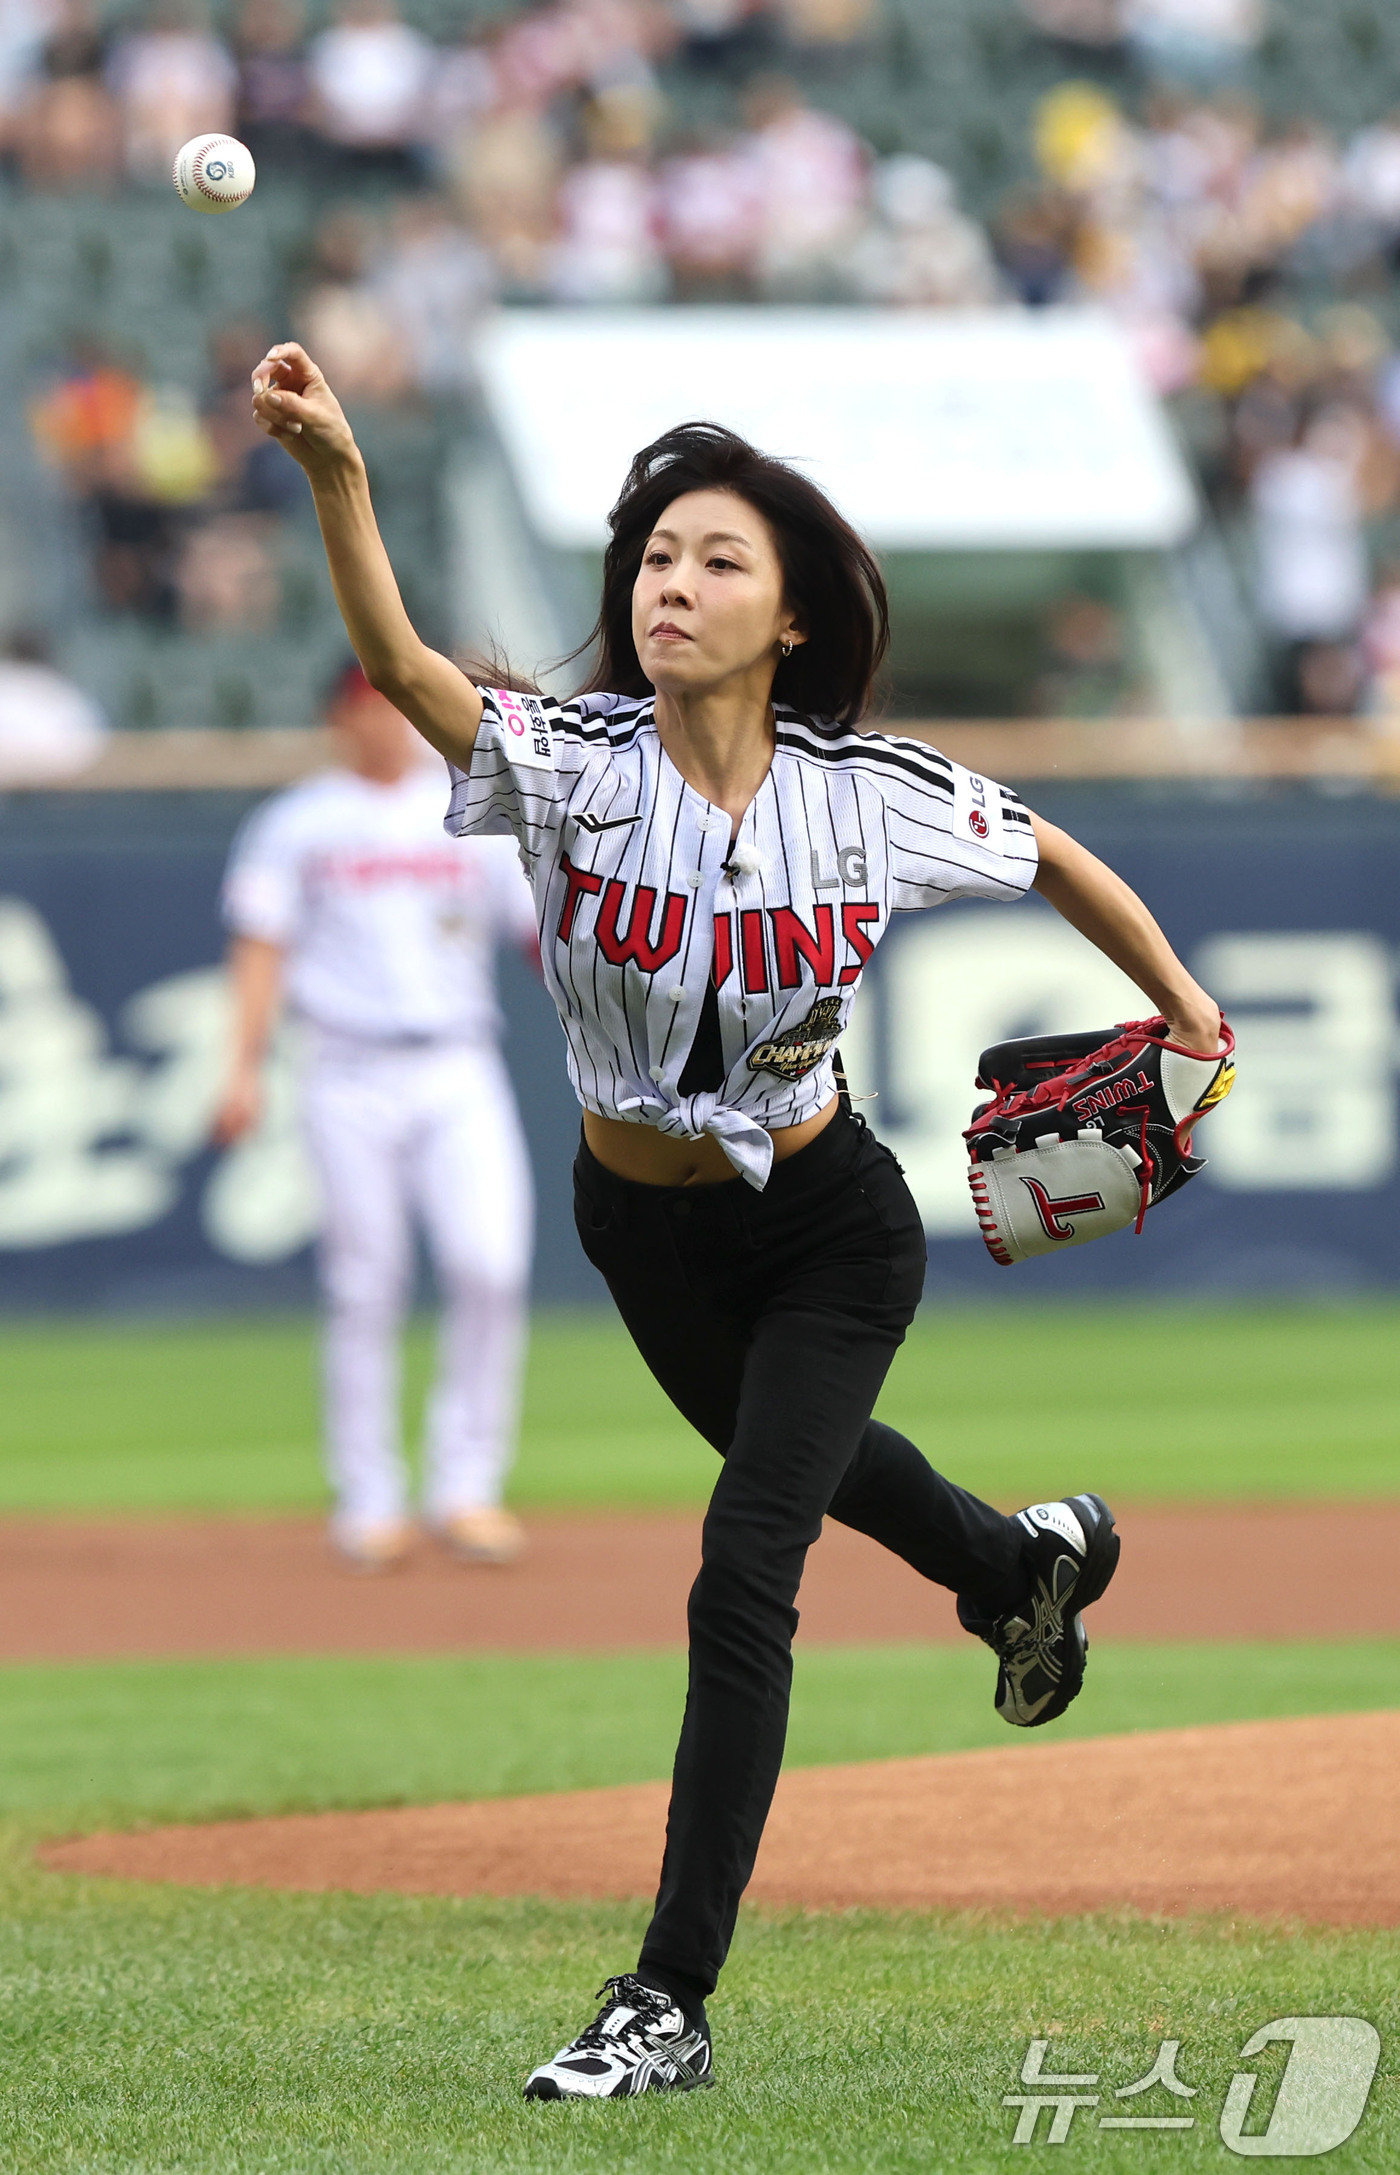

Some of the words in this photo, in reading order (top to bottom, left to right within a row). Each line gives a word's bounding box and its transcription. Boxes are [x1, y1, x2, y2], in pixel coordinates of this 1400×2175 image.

[521, 696, 551, 757] 통화앱
[969, 775, 986, 808] LG
[810, 846, 869, 889] LG
[556, 851, 880, 995] TWINS
[1072, 1070, 1155, 1122] TWINS
[1085, 1115, 1106, 1129] LG
